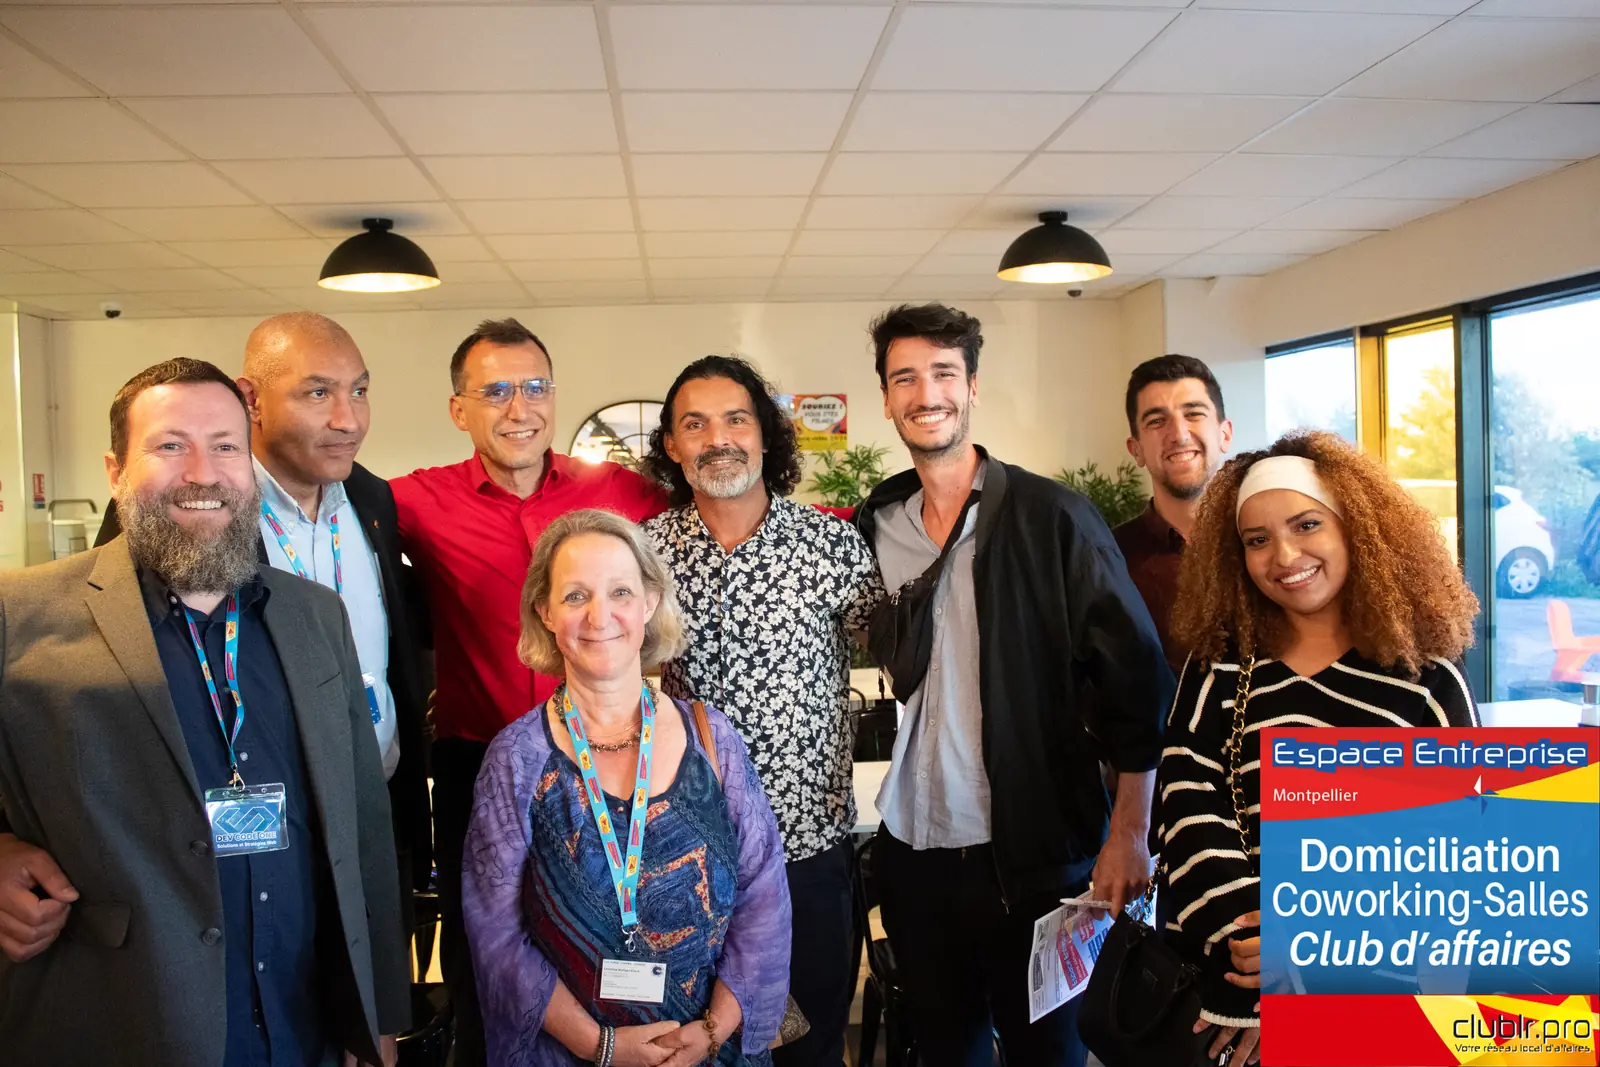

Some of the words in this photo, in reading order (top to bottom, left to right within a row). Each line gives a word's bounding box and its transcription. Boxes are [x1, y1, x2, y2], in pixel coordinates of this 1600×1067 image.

[216, 834, 233, 842] DEV
[234, 832, 258, 842] CODE
[259, 831, 276, 839] ONE
